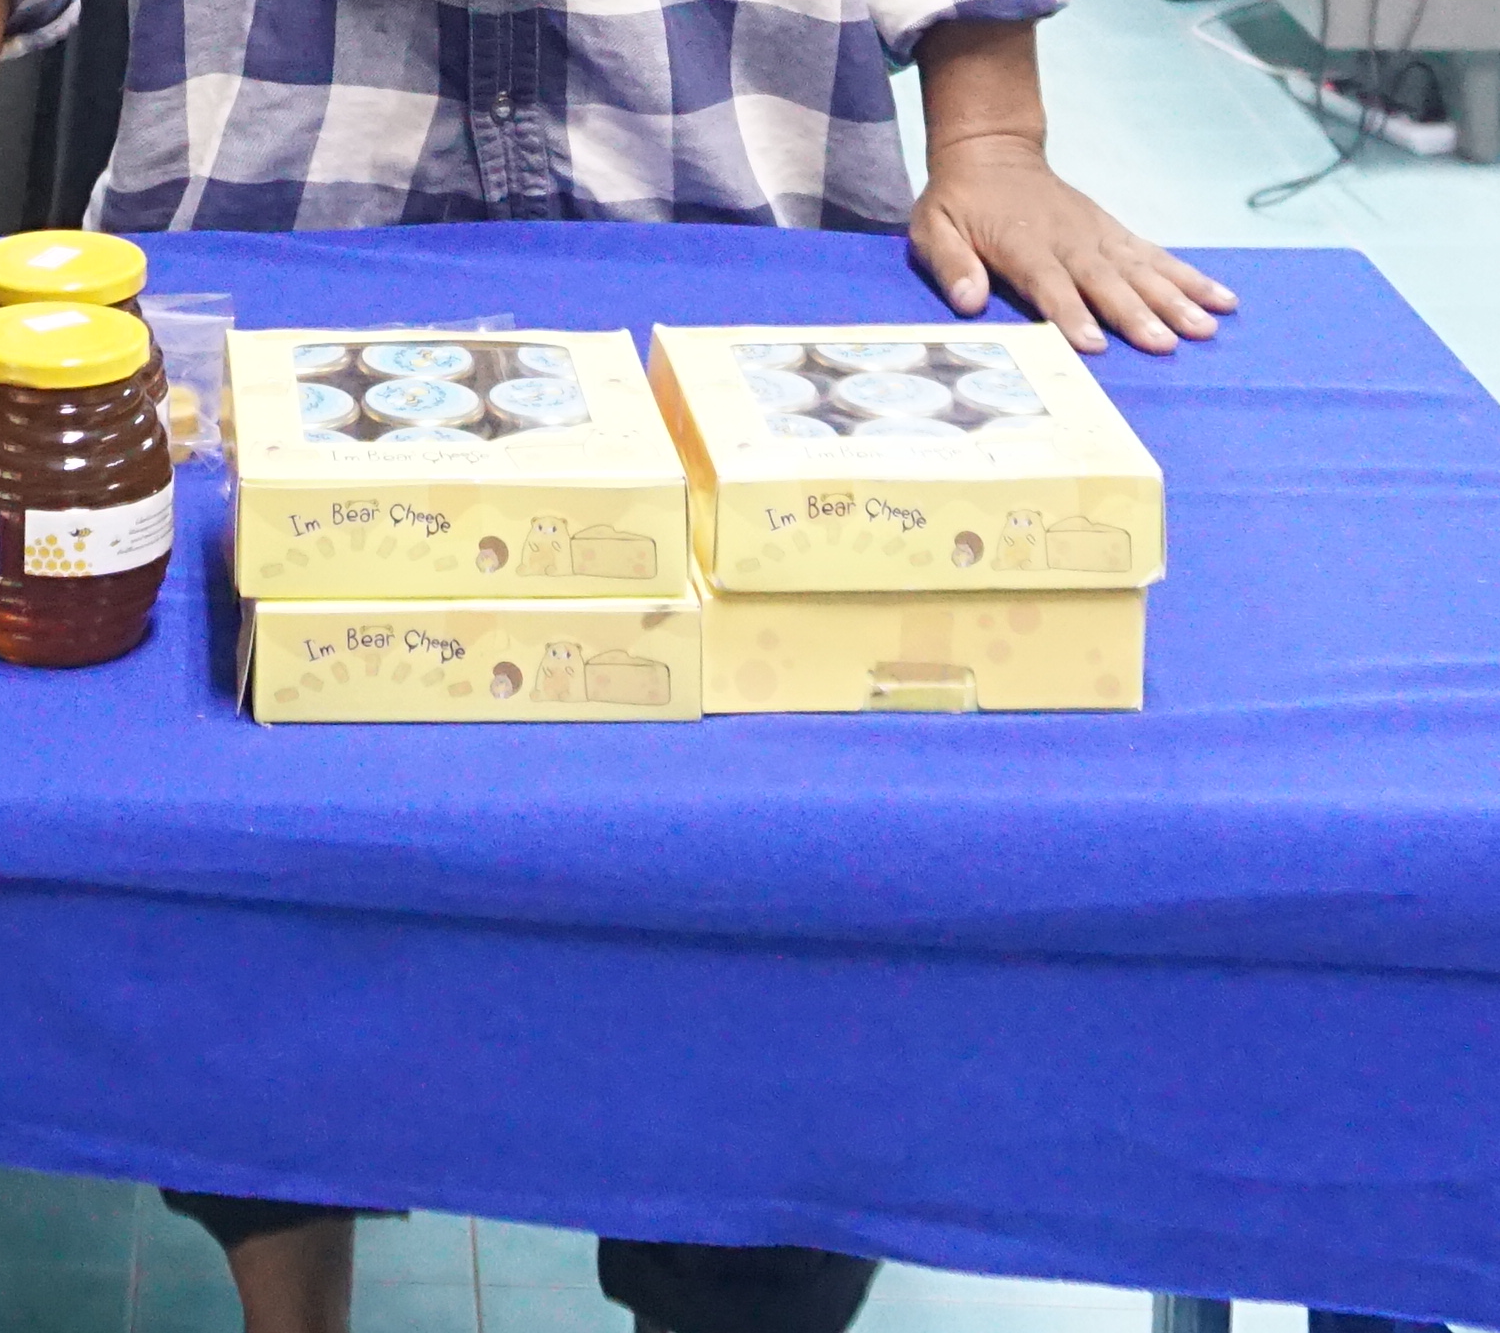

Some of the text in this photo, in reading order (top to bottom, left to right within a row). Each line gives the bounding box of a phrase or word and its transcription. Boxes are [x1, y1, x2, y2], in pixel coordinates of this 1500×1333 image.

[287, 502, 452, 538] I'm Bear Cheese
[765, 495, 928, 532] I'm Bear Cheese
[303, 627, 466, 664] I'm Bear Cheese
